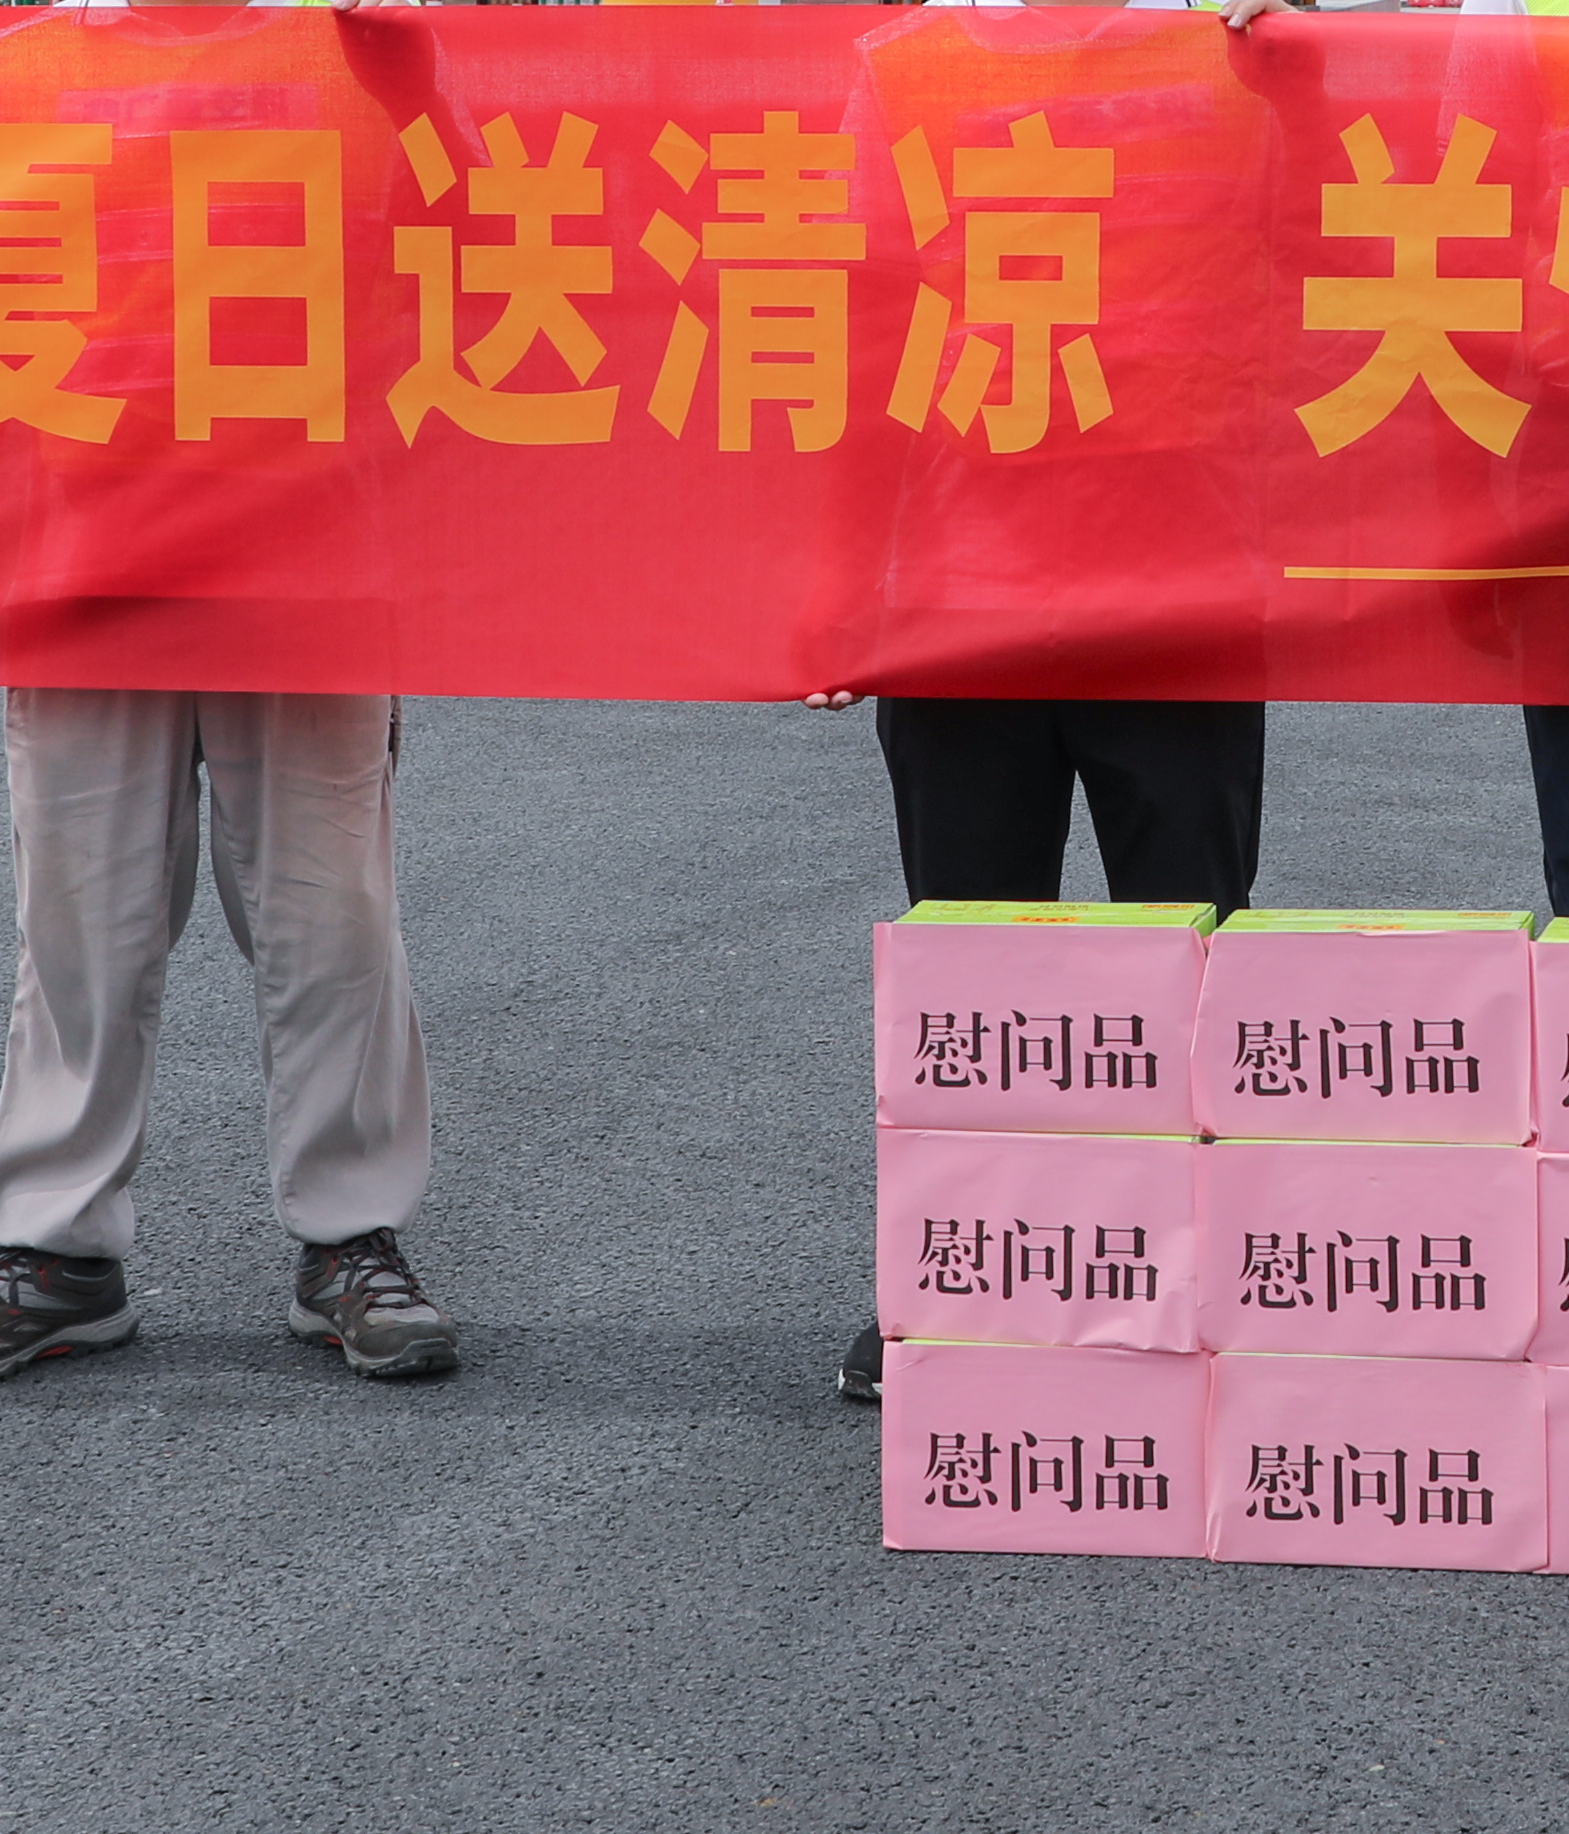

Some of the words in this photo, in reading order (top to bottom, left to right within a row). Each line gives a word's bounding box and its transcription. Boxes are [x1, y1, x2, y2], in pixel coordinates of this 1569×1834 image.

[915, 1010, 1159, 1091] 慰问品
[1234, 1017, 1481, 1098] 慰问品
[918, 1219, 1159, 1301] 慰问品
[1239, 1231, 1487, 1312] 慰问品
[924, 1431, 1170, 1512] 慰问品
[1245, 1443, 1494, 1526] 慰问品
